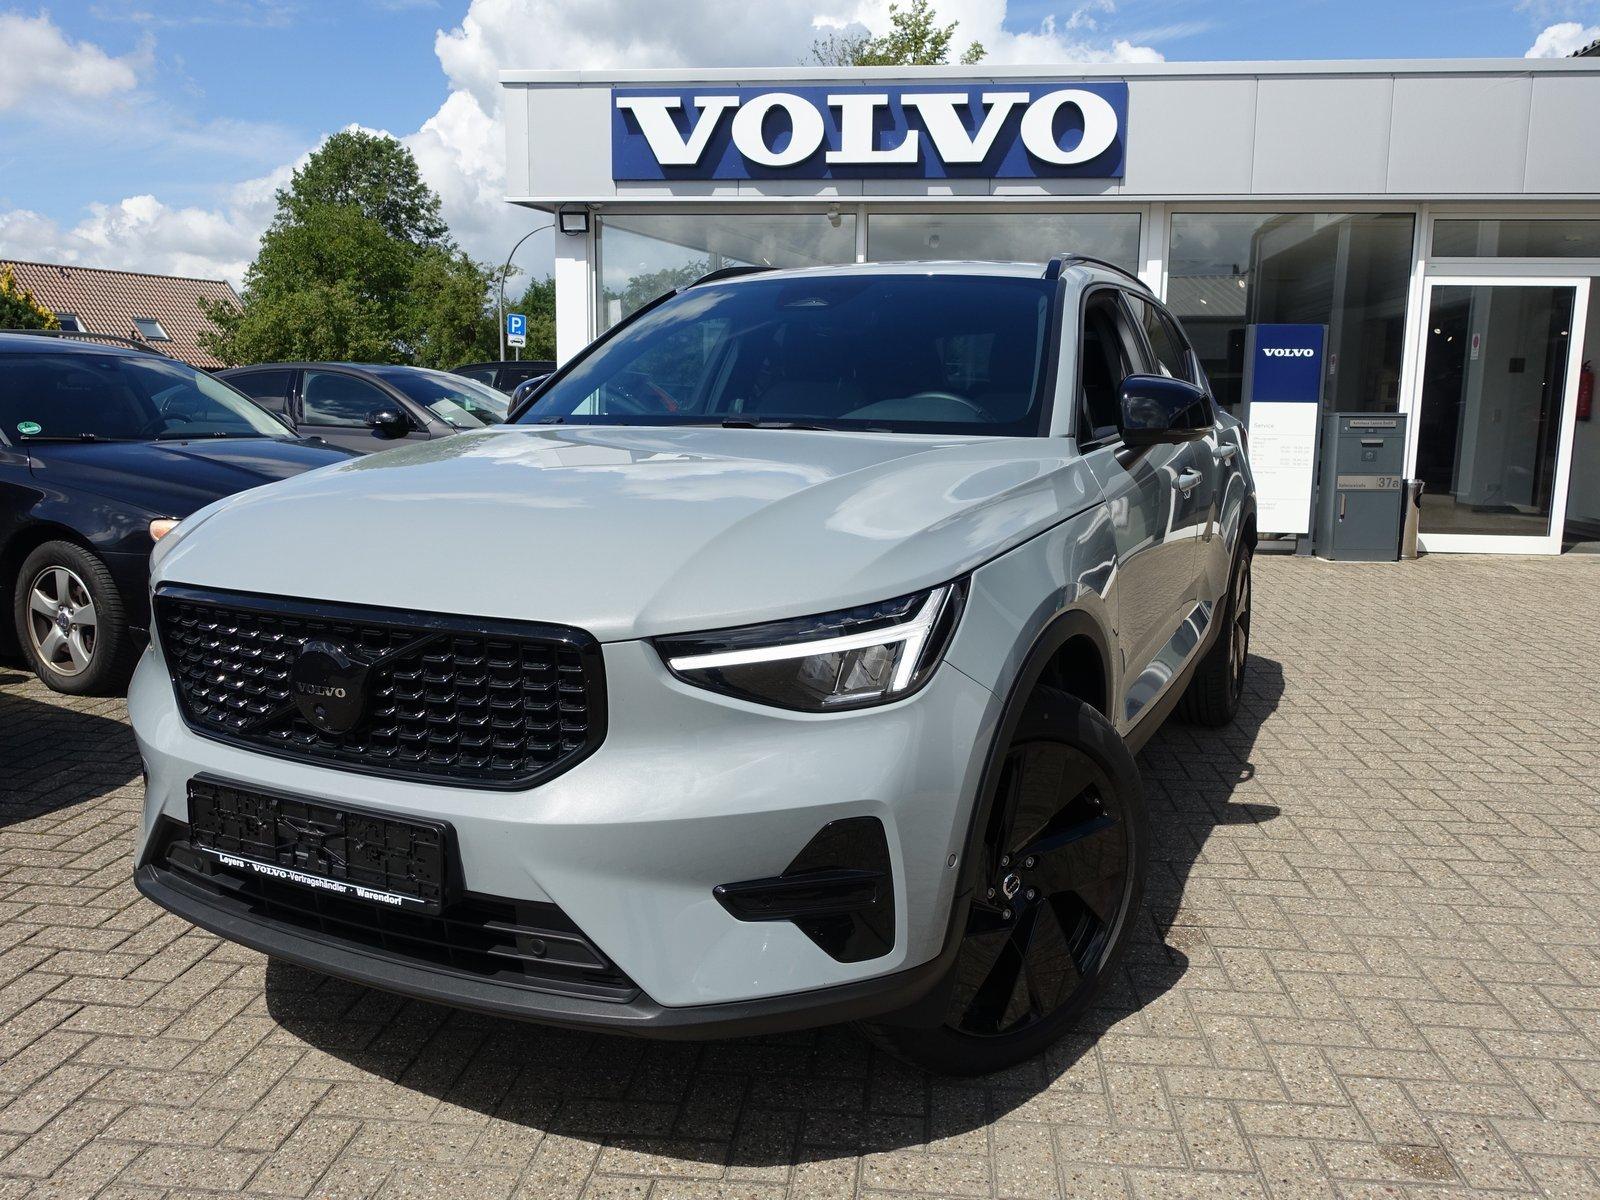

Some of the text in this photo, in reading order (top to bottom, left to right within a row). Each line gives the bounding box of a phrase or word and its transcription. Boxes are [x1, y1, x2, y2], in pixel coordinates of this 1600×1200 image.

[616, 89, 1118, 165] VOLVO
[511, 316, 522, 333] P
[1262, 348, 1314, 357] VOLVO
[1378, 477, 1399, 488] 37a
[296, 681, 346, 698] VOLVO
[219, 853, 245, 868] Leyers
[355, 887, 402, 906] Warendorf
